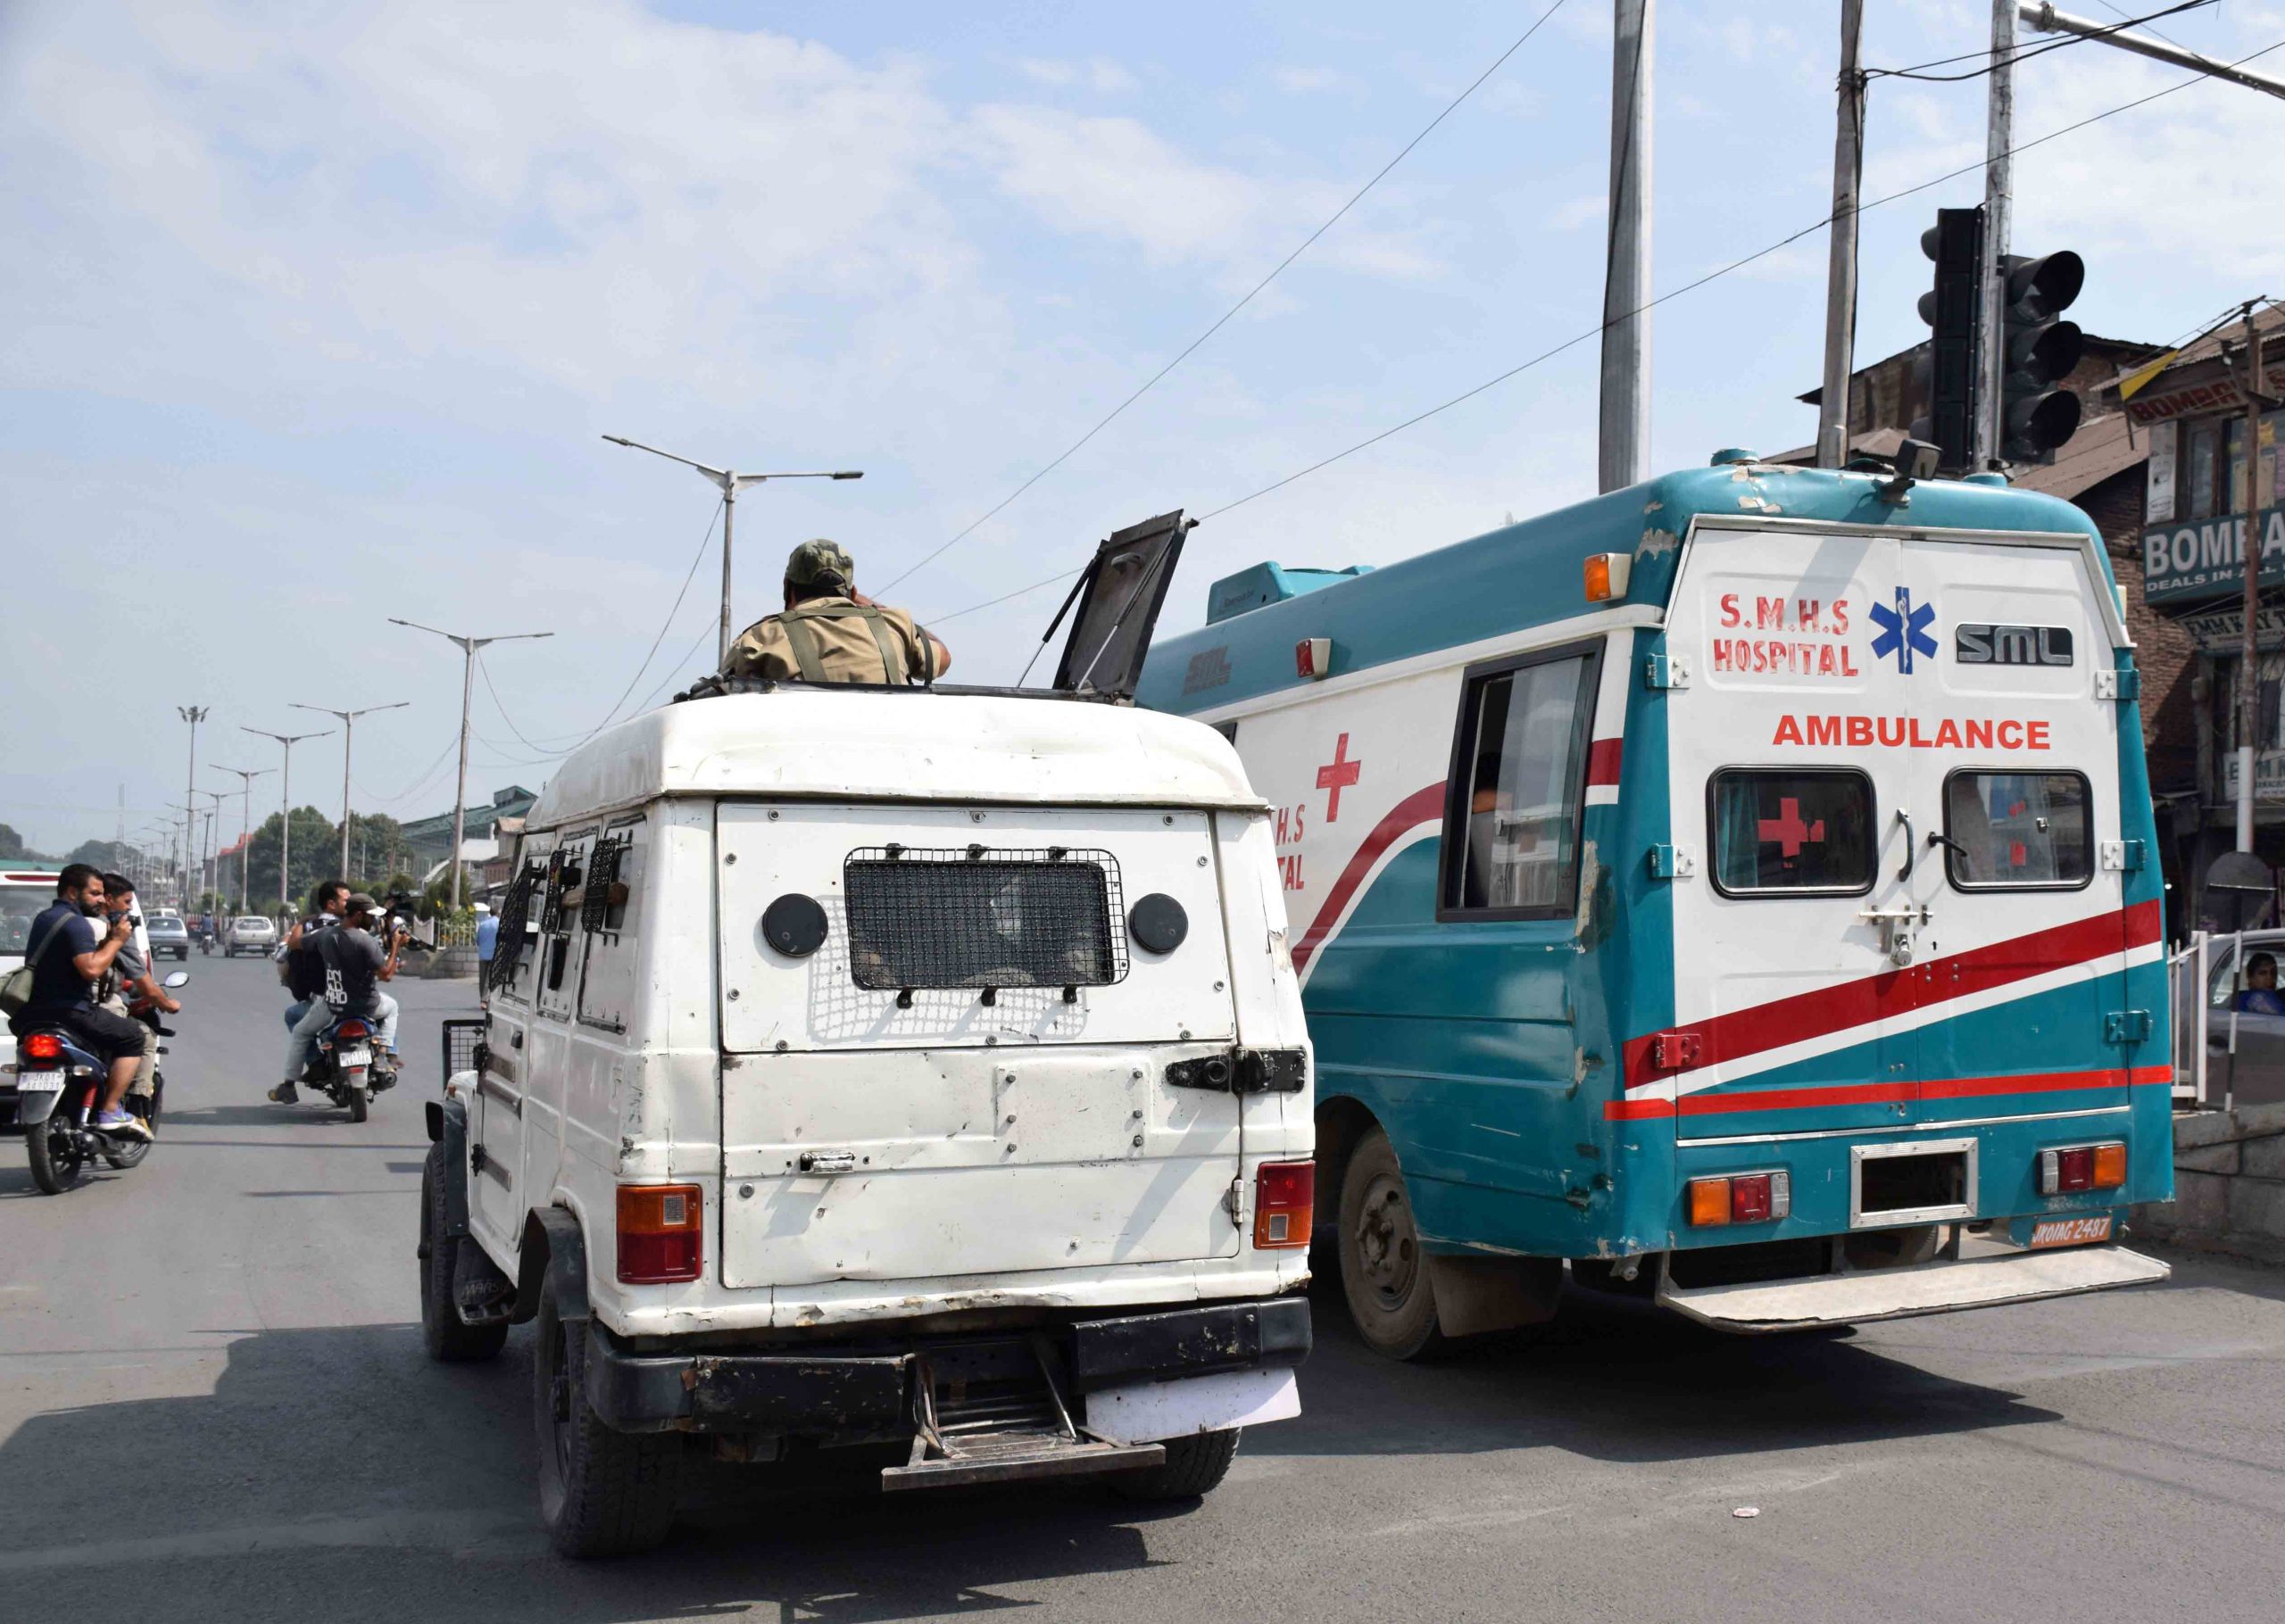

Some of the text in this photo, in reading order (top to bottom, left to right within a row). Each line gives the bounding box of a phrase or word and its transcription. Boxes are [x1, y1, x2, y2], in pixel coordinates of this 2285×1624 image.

[2146, 573, 2206, 593] DEALS
[2212, 569, 2232, 583] IN
[1720, 593, 1849, 636] S.M.H.S
[2228, 611, 2273, 634] KY
[1713, 639, 1859, 676] HOSPITAL
[1957, 625, 2072, 664] SML
[1773, 715, 2050, 750] AMBULANCE
[2073, 1217, 2110, 1239] 2487
